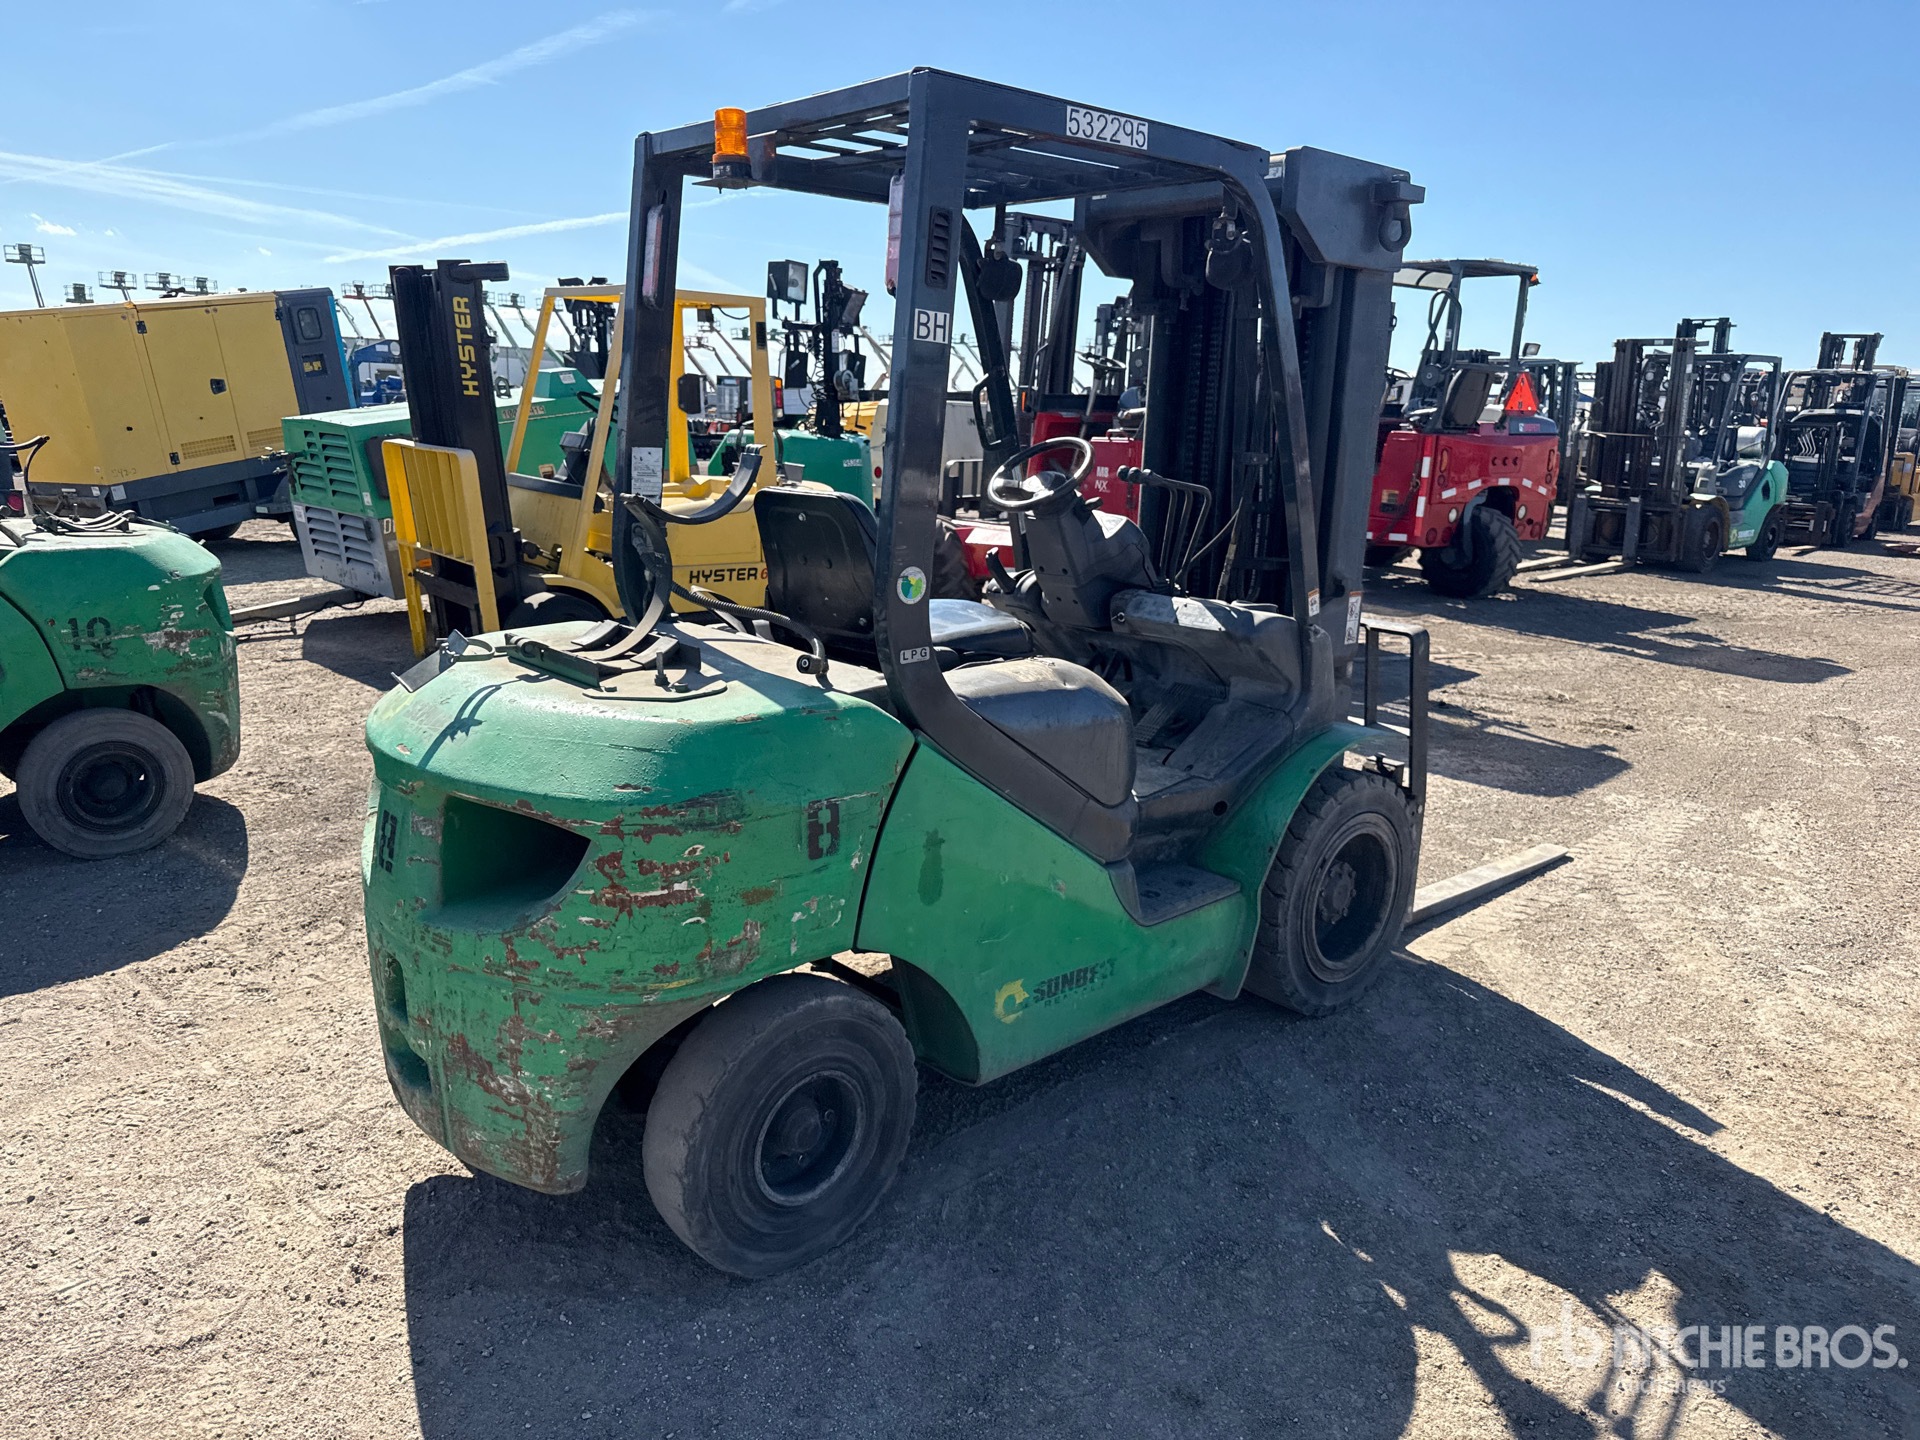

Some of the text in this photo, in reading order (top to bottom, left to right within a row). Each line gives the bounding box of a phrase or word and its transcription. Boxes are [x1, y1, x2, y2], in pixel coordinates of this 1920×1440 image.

[1068, 108, 1147, 148] 532295
[917, 310, 947, 342] BH
[452, 296, 480, 396] HYSTER
[689, 567, 758, 584] HYSTER
[67, 616, 112, 651] 10
[902, 648, 928, 661] LPG
[807, 797, 840, 860] 8
[1032, 958, 1117, 1004] SUNBET
